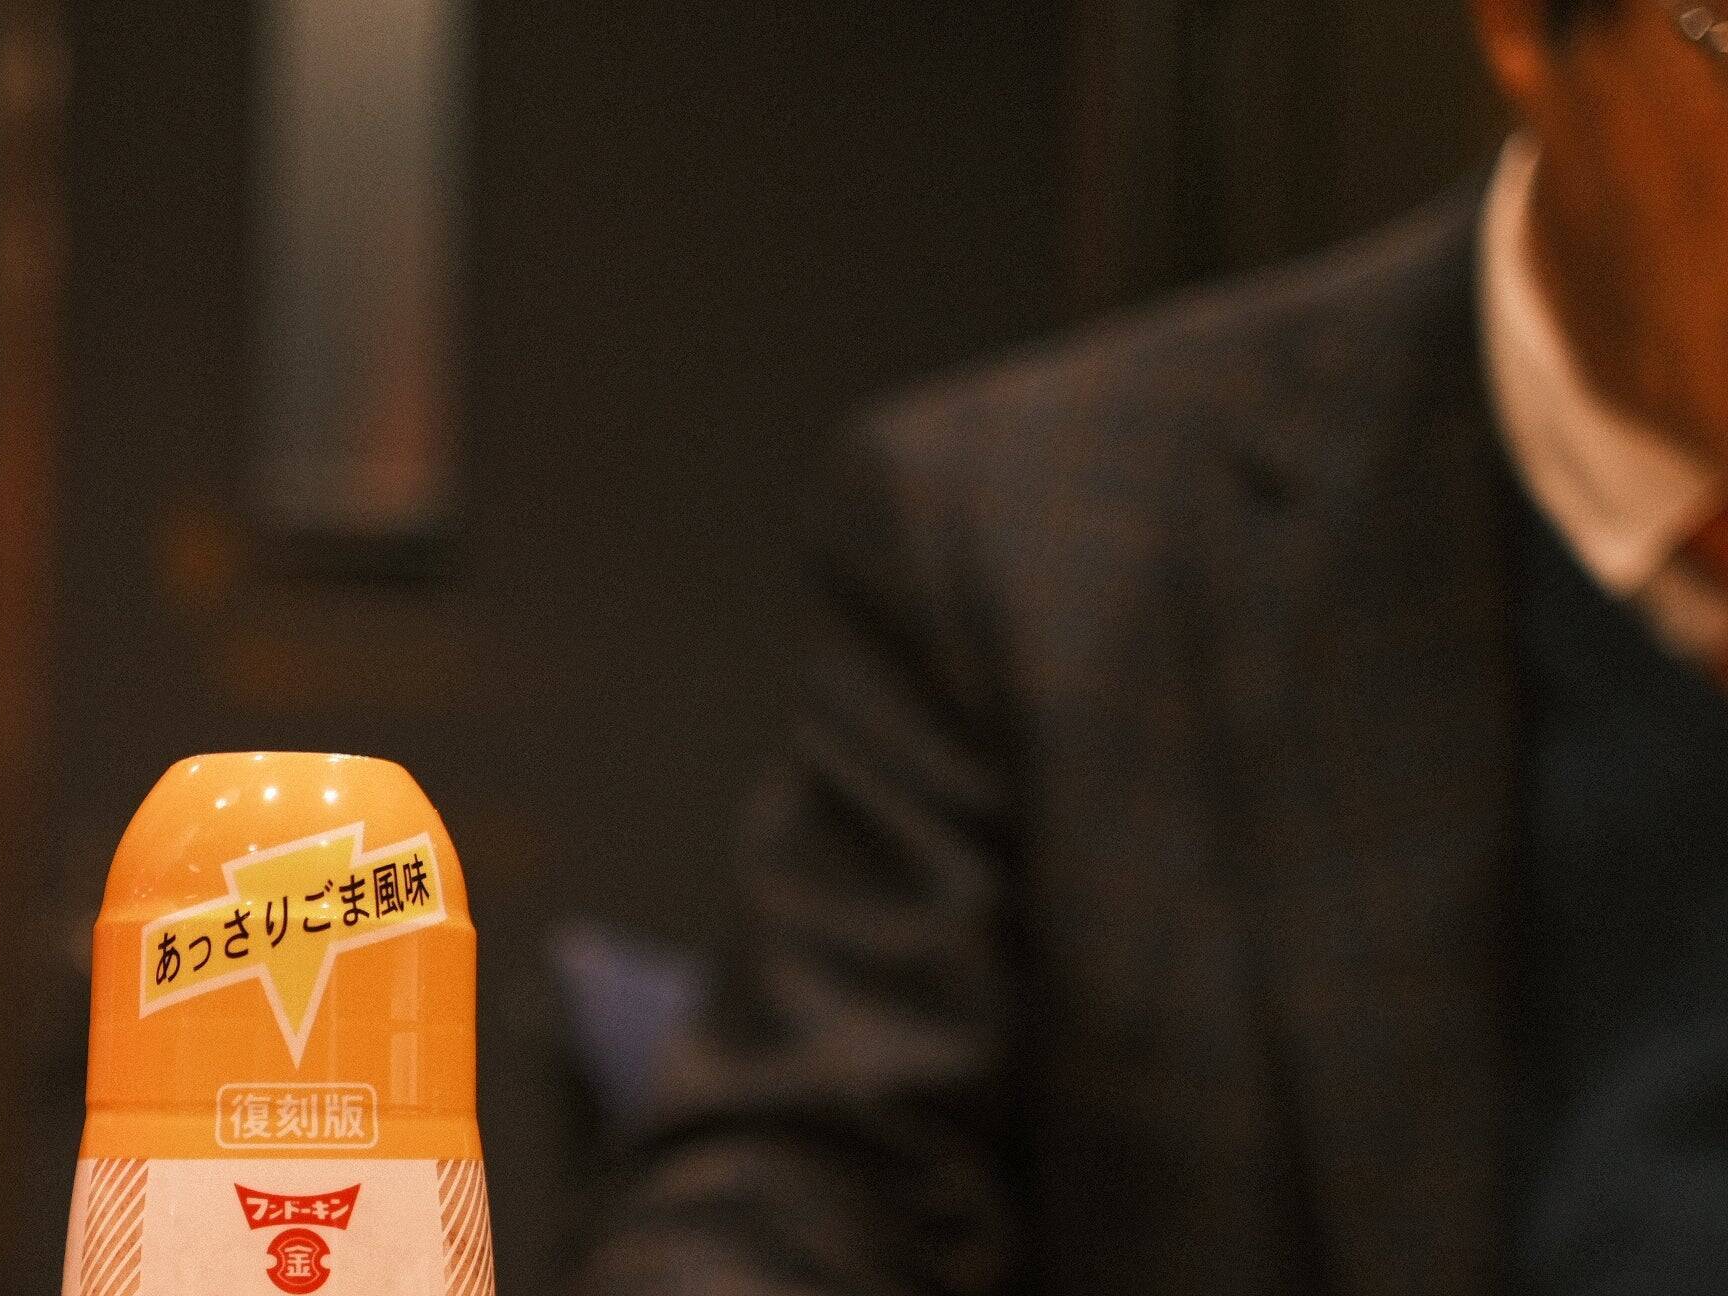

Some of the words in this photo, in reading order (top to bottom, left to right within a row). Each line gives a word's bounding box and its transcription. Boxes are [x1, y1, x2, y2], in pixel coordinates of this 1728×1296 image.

[155, 854, 431, 985] あっさりごま風味
[229, 1093, 366, 1139] 復刻版
[246, 1197, 350, 1221] フンドーキン
[284, 1245, 313, 1277] 金
